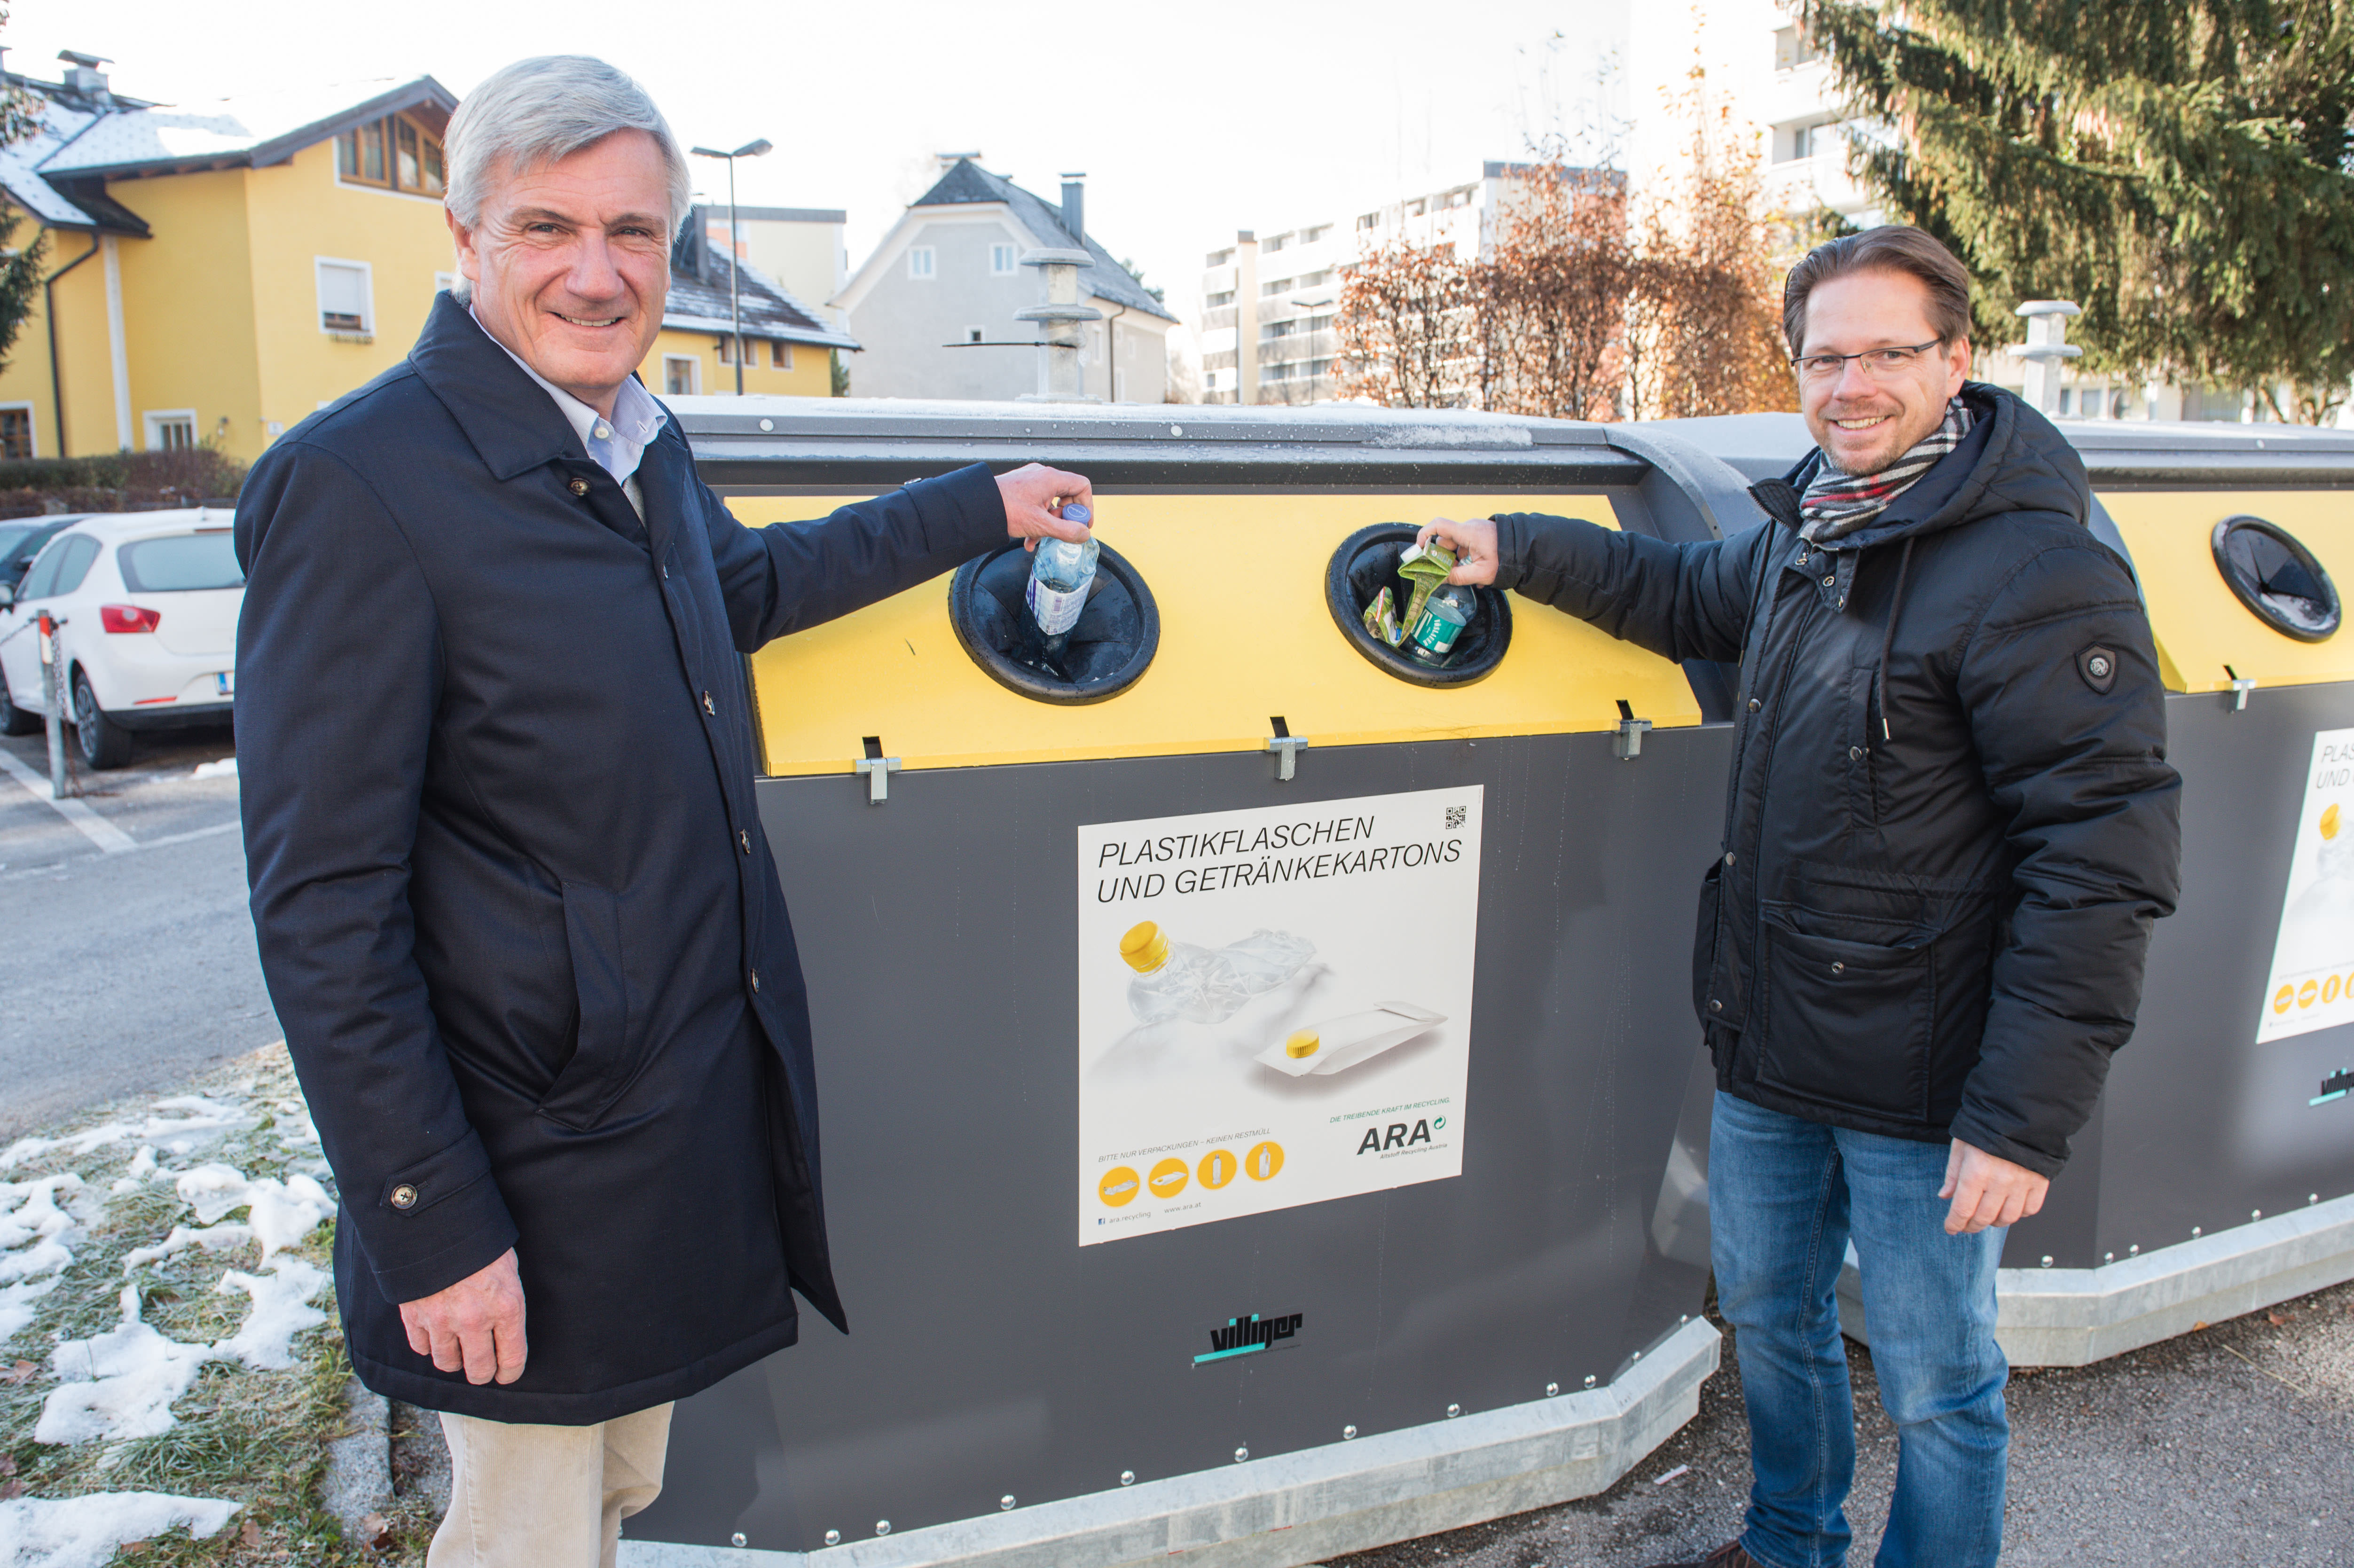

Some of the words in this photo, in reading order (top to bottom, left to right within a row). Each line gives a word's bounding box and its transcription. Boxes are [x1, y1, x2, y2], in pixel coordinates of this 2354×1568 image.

[2316, 768, 2350, 789] UND
[1099, 816, 1374, 868] PLASTIKFLASCHEN
[1098, 874, 1165, 903] UND
[1175, 839, 1462, 894] GETRÄNKEKARTONS
[1343, 1109, 1381, 1121] TREIBENDE
[1381, 1105, 1403, 1114] KRAFT
[1098, 1154, 1118, 1162] BITTE
[1120, 1150, 1137, 1159] NUR
[1138, 1140, 1199, 1156] VERPACKUNGEN
[1206, 1134, 1233, 1144] KEINEN
[1234, 1127, 1271, 1139] RESTMÜLL
[1357, 1119, 1431, 1155] ARA
[1401, 1146, 1427, 1156] Recycling
[1109, 1212, 1151, 1223] ara.recycling
[1164, 1202, 1201, 1214] www.ara.at
